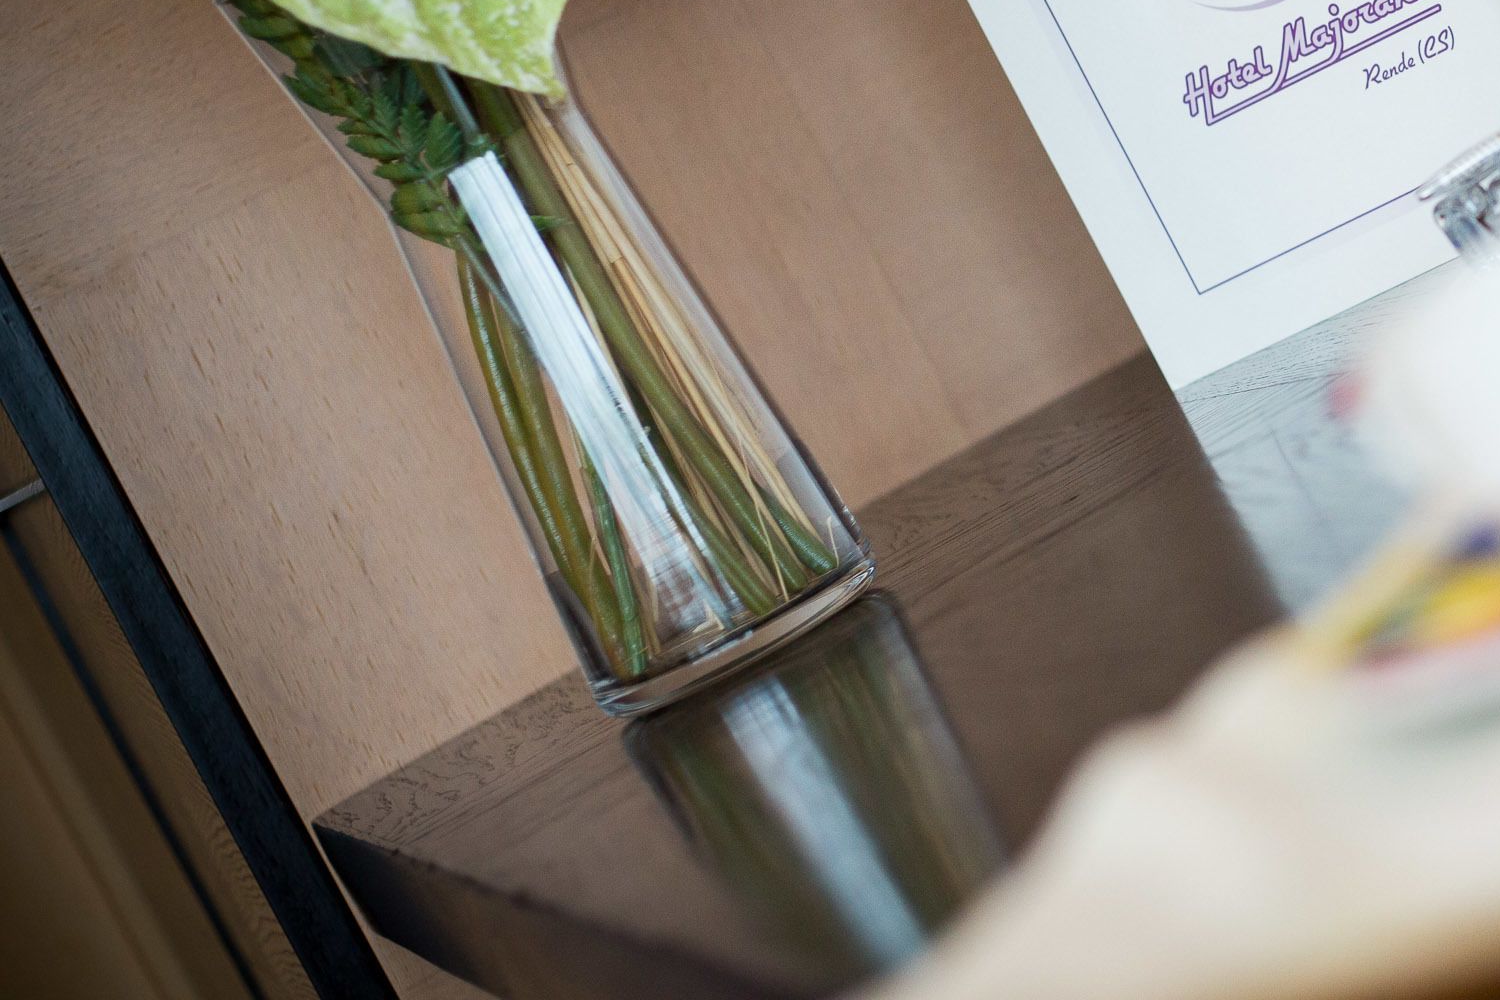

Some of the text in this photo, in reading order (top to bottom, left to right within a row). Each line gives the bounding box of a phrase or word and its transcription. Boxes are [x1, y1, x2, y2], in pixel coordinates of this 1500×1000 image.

[1183, 45, 1273, 126] Hotel
[1362, 25, 1456, 90] Rende (CS)
